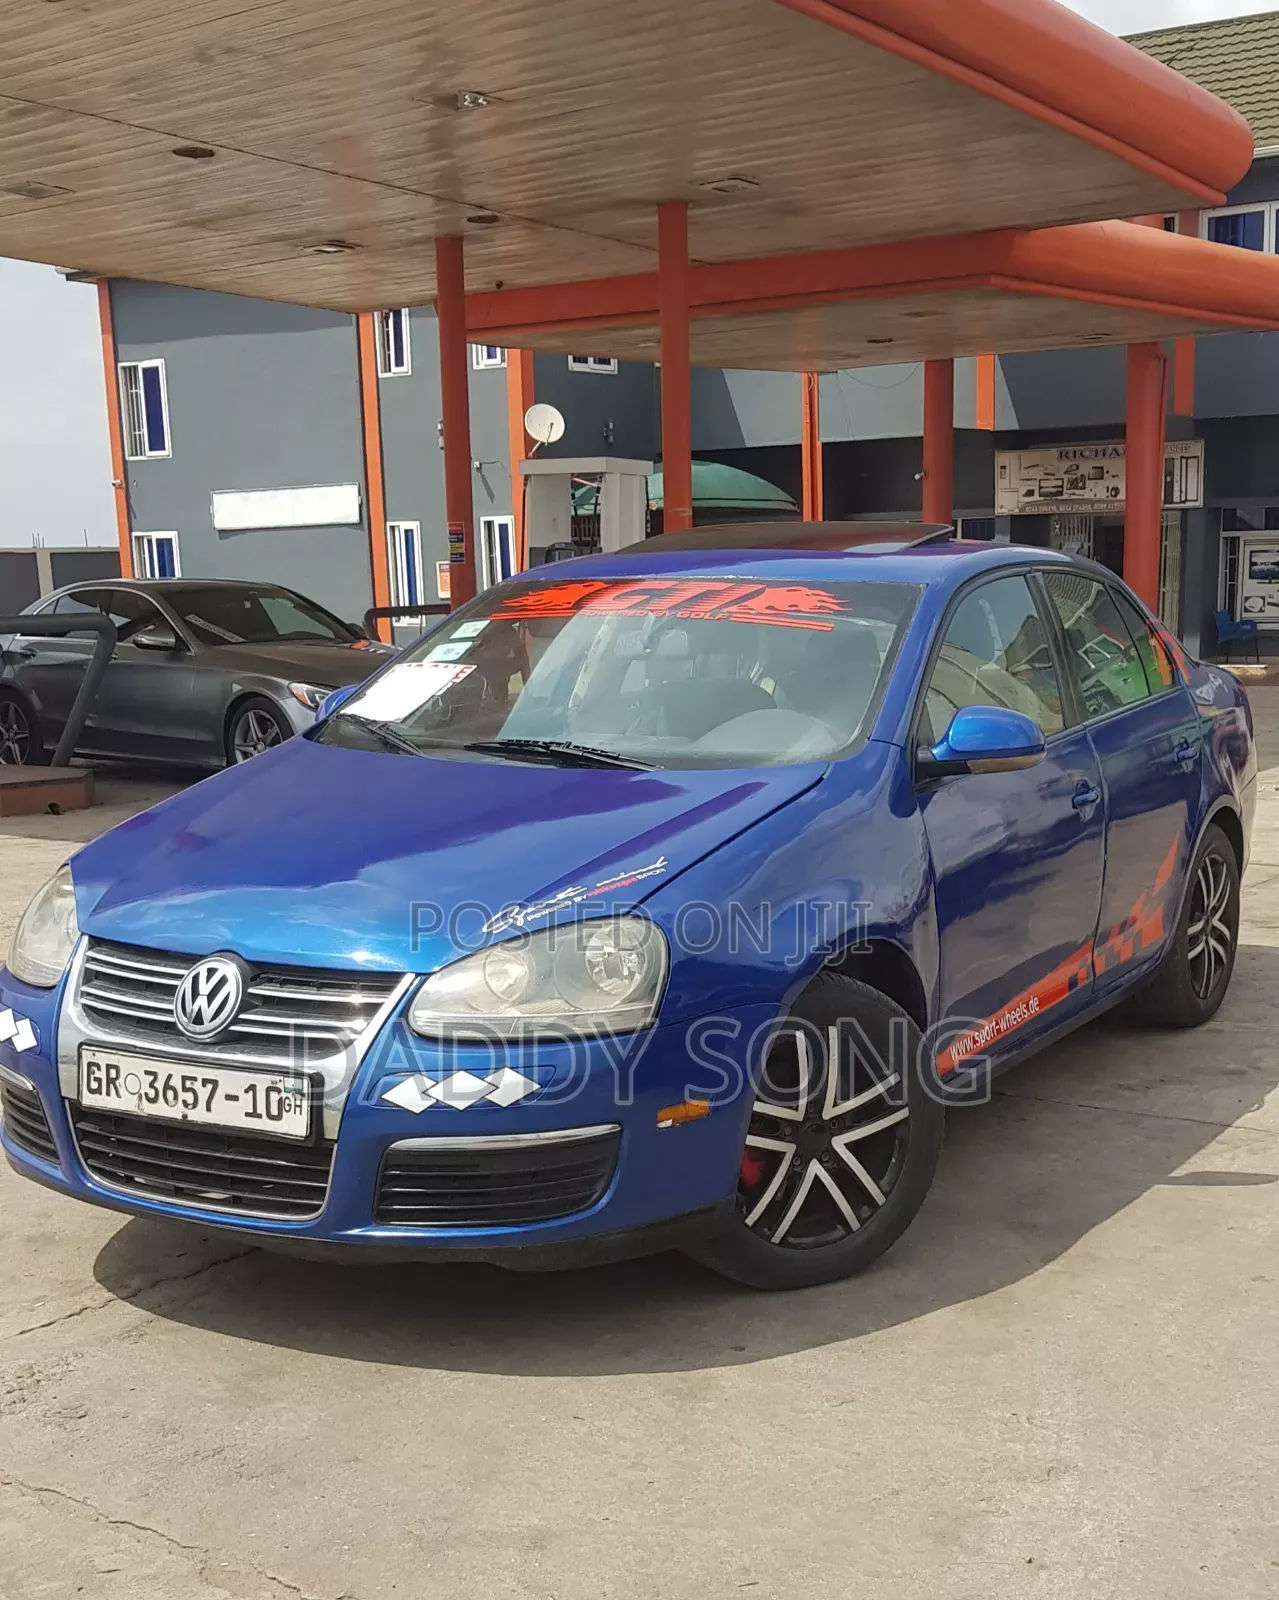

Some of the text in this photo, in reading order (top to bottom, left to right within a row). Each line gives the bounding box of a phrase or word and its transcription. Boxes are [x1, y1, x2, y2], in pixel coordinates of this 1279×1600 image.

[1058, 447, 1126, 460] RICHA
[581, 580, 767, 611] GTI
[579, 610, 730, 620] POWERED BY GOLF
[950, 996, 1039, 1060] www.sport-wheels.de
[86, 1060, 122, 1099] GR
[283, 1095, 303, 1116] GH
